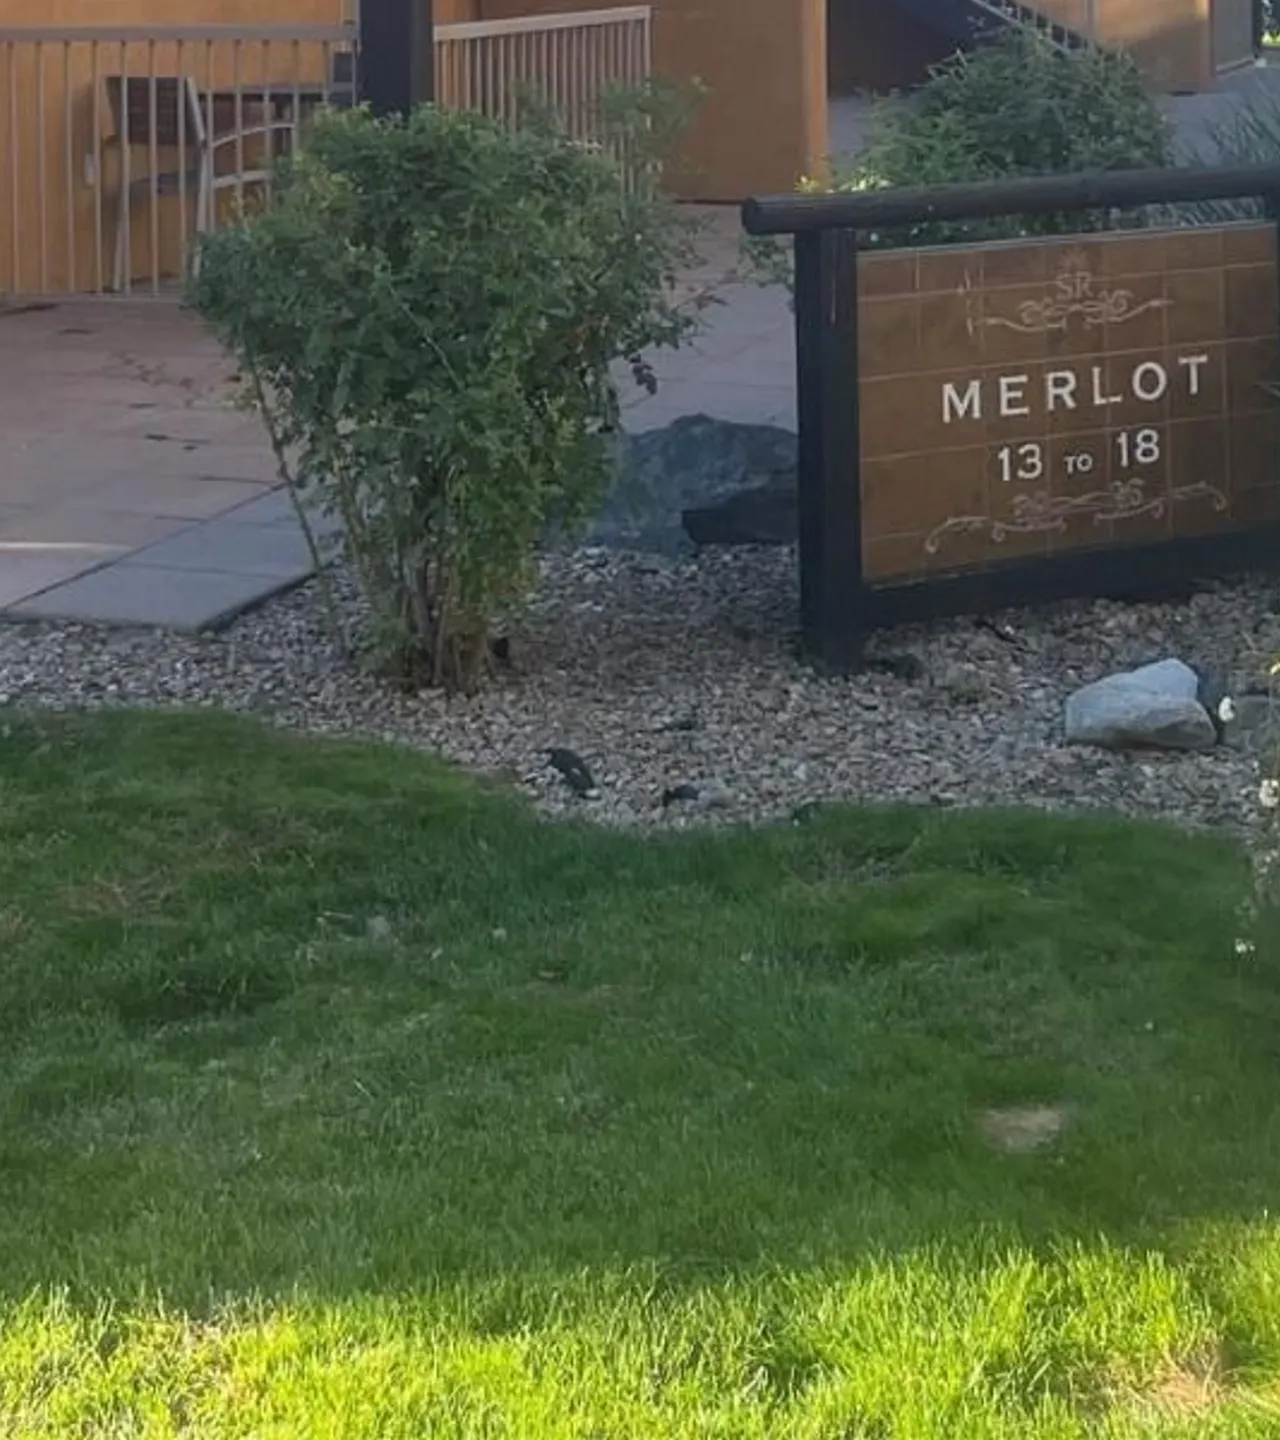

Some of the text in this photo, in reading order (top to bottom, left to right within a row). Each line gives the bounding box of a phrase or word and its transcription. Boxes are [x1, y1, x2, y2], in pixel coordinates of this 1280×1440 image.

[941, 354, 1208, 424] MERLOT
[998, 428, 1160, 481] 13 TO 18
